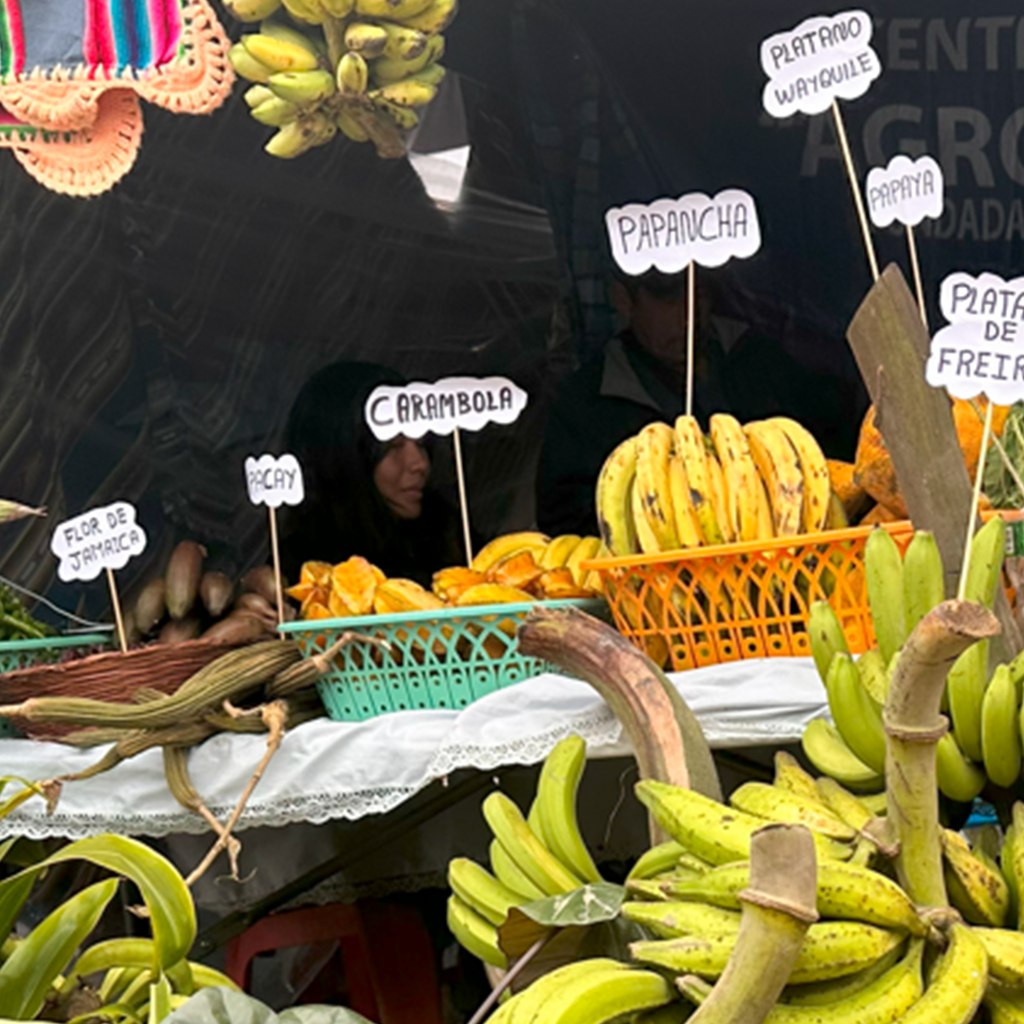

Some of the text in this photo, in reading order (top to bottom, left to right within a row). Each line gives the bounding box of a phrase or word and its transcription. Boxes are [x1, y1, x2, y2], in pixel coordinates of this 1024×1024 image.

[770, 16, 862, 69] PLATANO
[774, 52, 873, 106] WAYQUILE
[869, 169, 935, 211] PAPAYA
[617, 203, 748, 254] PAPANCHA
[984, 321, 1018, 342] DE
[370, 386, 513, 426] CARAMBOLA
[249, 467, 298, 491] PACAY
[63, 507, 127, 547] FLOR DE
[68, 529, 140, 571] JAMAICA
